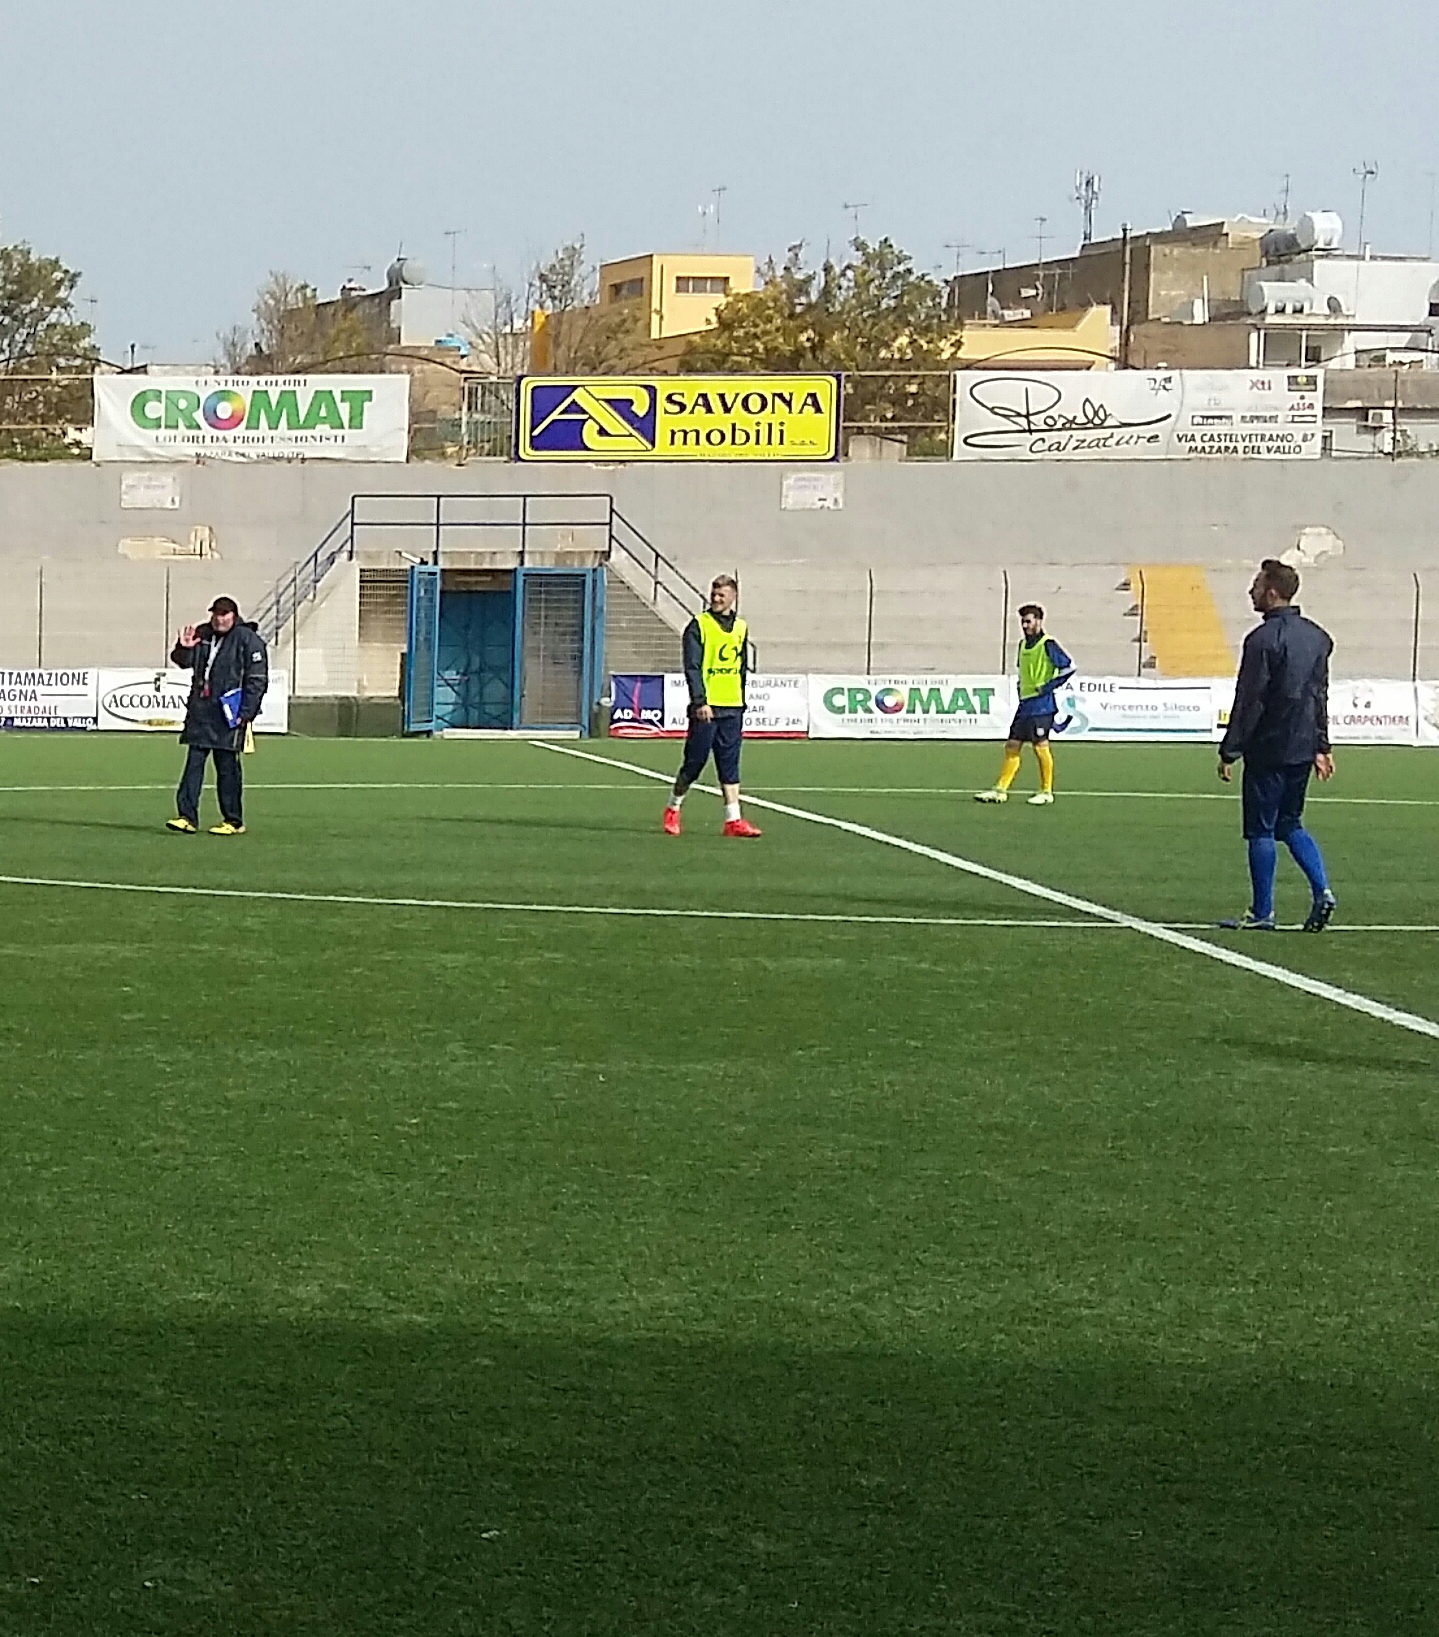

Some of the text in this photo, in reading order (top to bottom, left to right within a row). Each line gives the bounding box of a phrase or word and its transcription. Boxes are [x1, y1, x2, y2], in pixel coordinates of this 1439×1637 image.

[129, 388, 374, 431] CROMAT
[663, 391, 825, 416] SAVONA
[668, 420, 786, 447] mobili
[1029, 432, 1161, 454] Calzature
[1176, 432, 1199, 444] VIA
[1187, 445, 1302, 455] MAZARA DEL VALLO
[1079, 681, 1117, 693] EDILE
[822, 686, 996, 715] CROMAT
[756, 716, 781, 727] SELF
